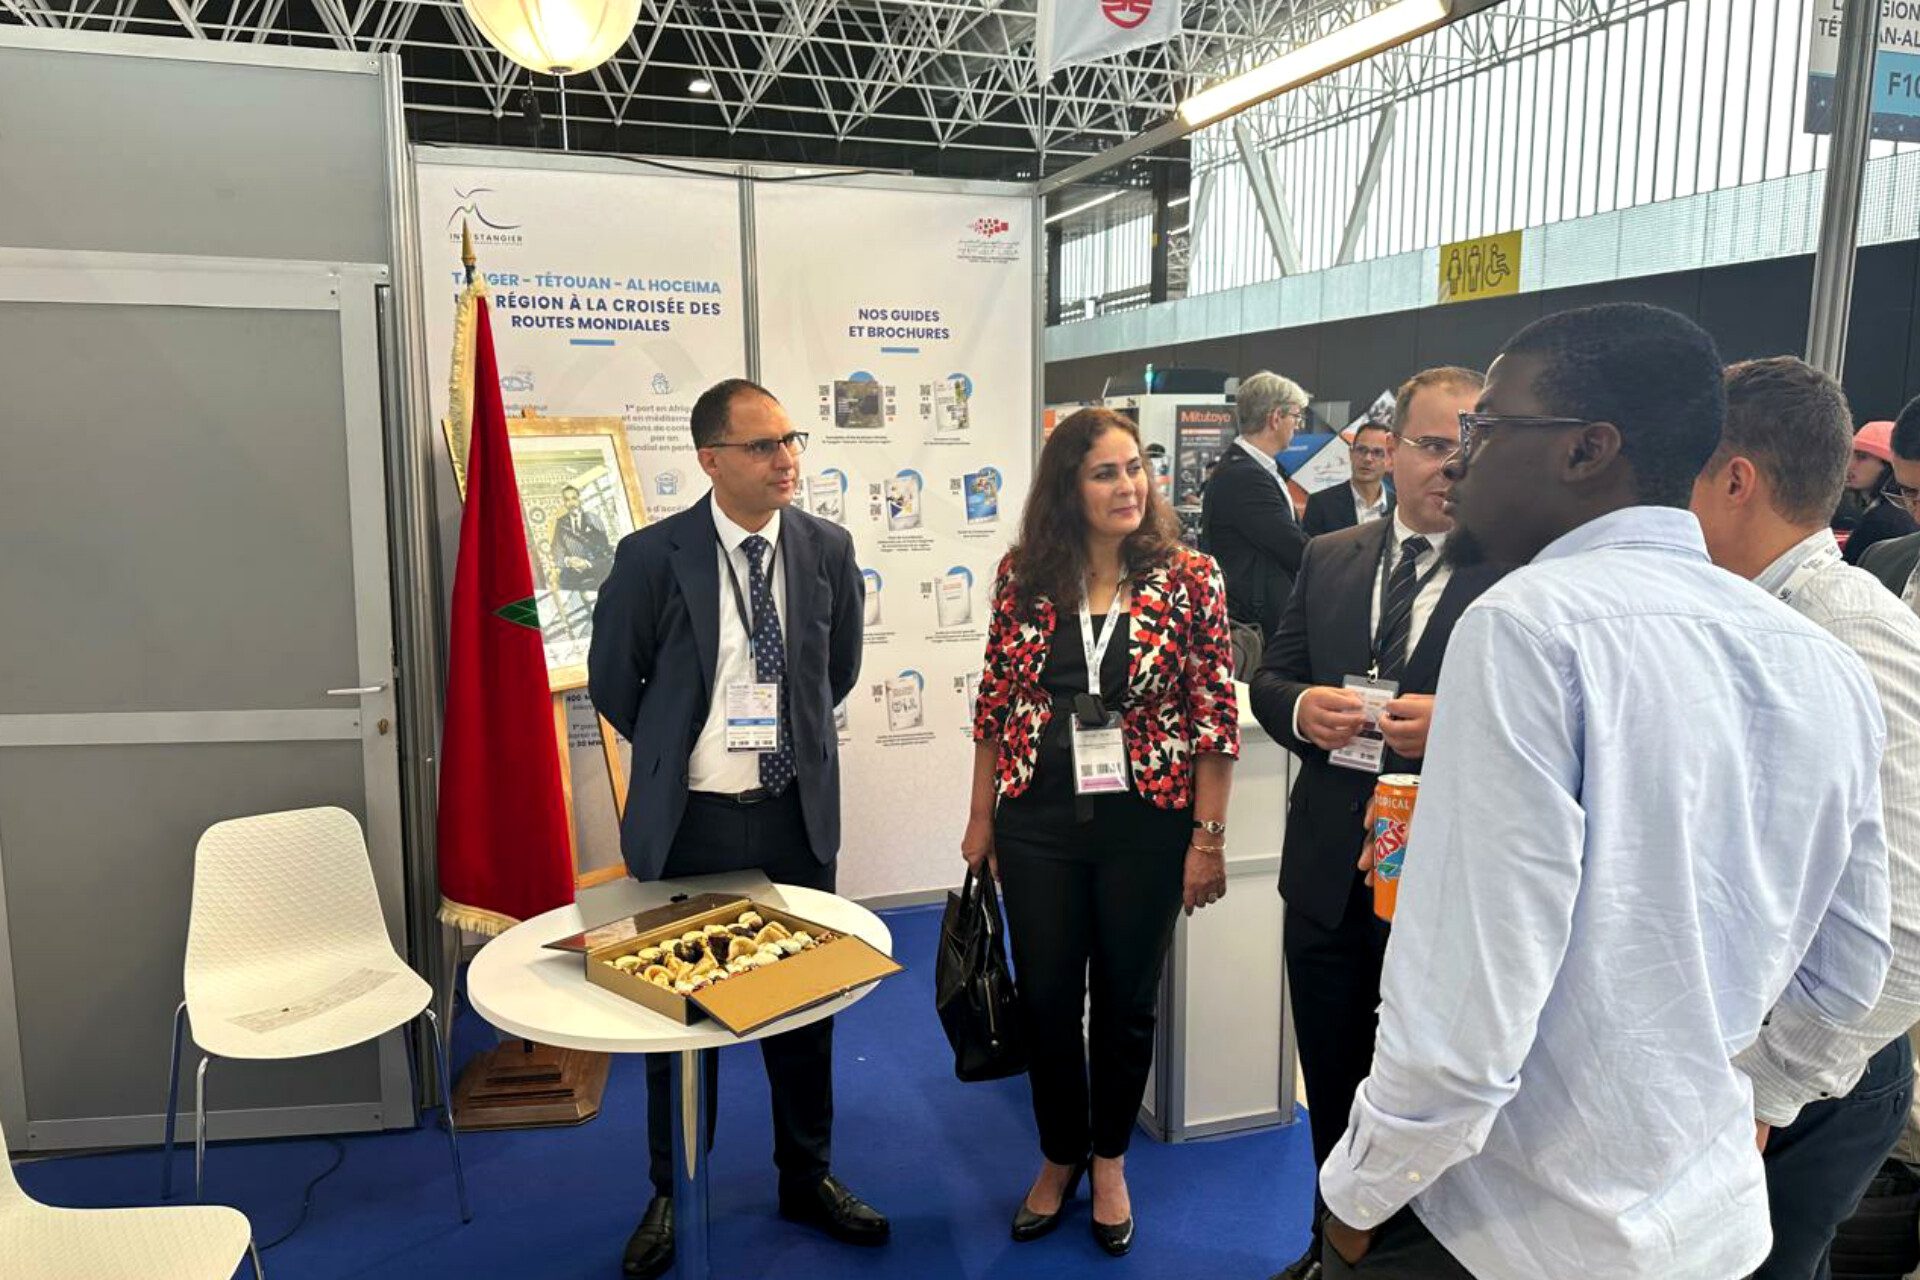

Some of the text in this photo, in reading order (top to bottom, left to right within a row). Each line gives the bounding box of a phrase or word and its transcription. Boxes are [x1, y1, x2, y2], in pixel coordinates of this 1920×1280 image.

[535, 271, 611, 289] TÉTOUAN
[627, 278, 646, 291] AL
[648, 279, 721, 293] HOCEIMA
[495, 290, 721, 315] RÉGION À LA CROISÉE DES
[858, 308, 940, 322] NOS GUIDES
[511, 315, 670, 332] ROUTES MONDIALES
[848, 325, 950, 339] ET BROCHURES
[1181, 410, 1232, 423] Mitutoyo
